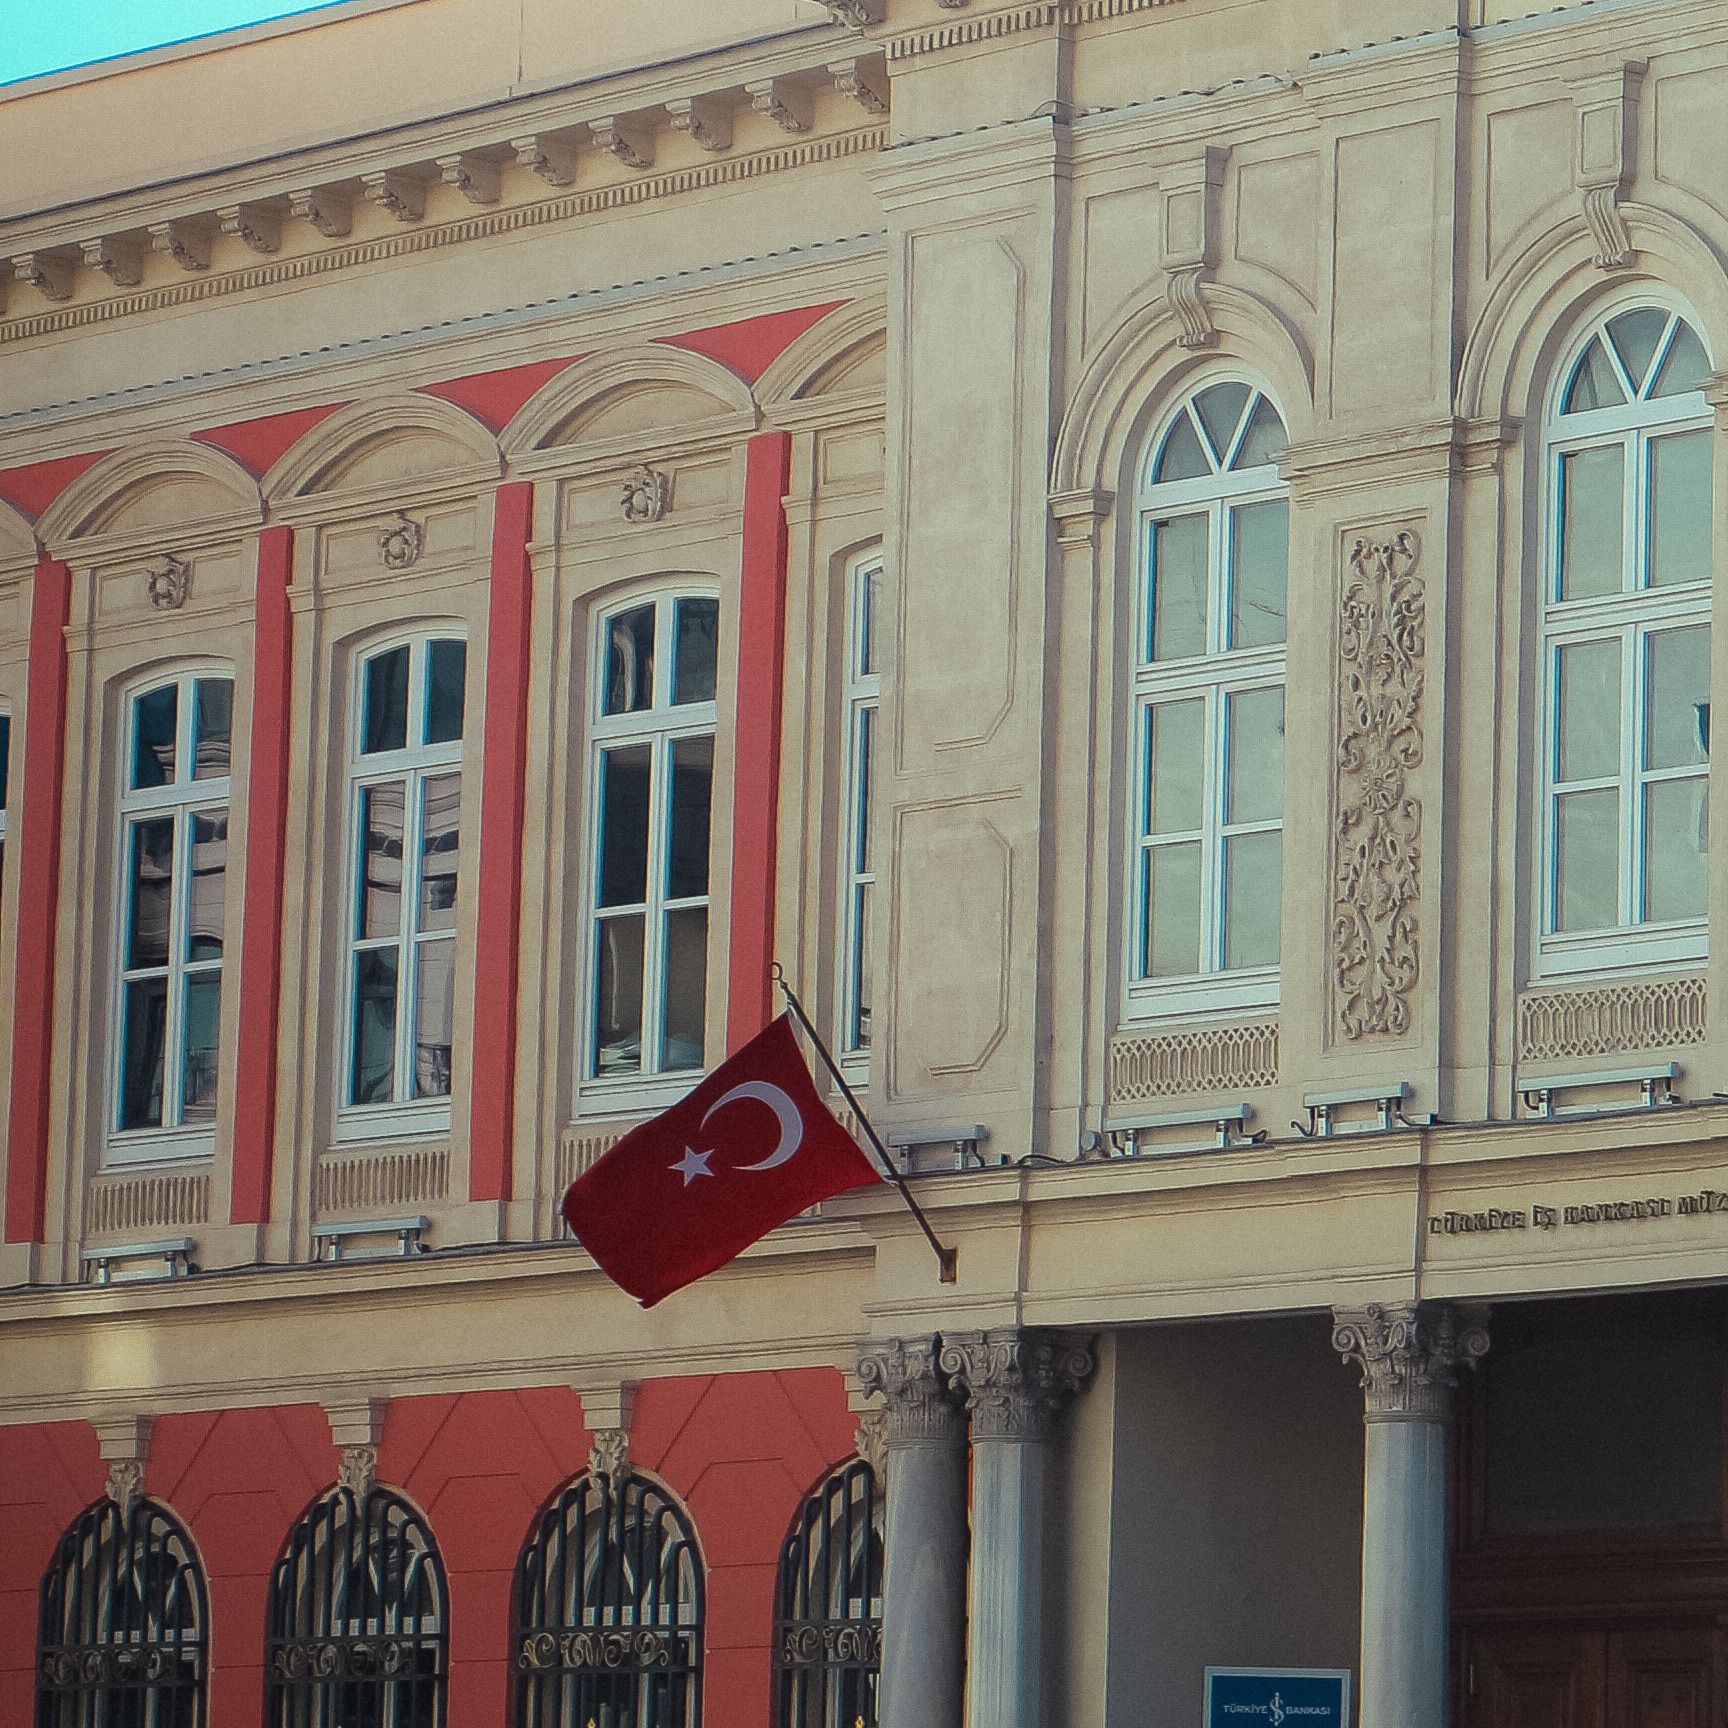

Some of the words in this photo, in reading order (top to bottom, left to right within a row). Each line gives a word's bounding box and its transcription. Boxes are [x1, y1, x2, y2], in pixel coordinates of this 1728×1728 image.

[1427, 1207, 1526, 1235] TÜRKİYE
[1531, 1203, 1557, 1231] İŞ
[1562, 1197, 1671, 1225] BANKASI
[1223, 1703, 1268, 1715] TÜRKİYE
[1285, 1706, 1332, 1716] BANKASI
